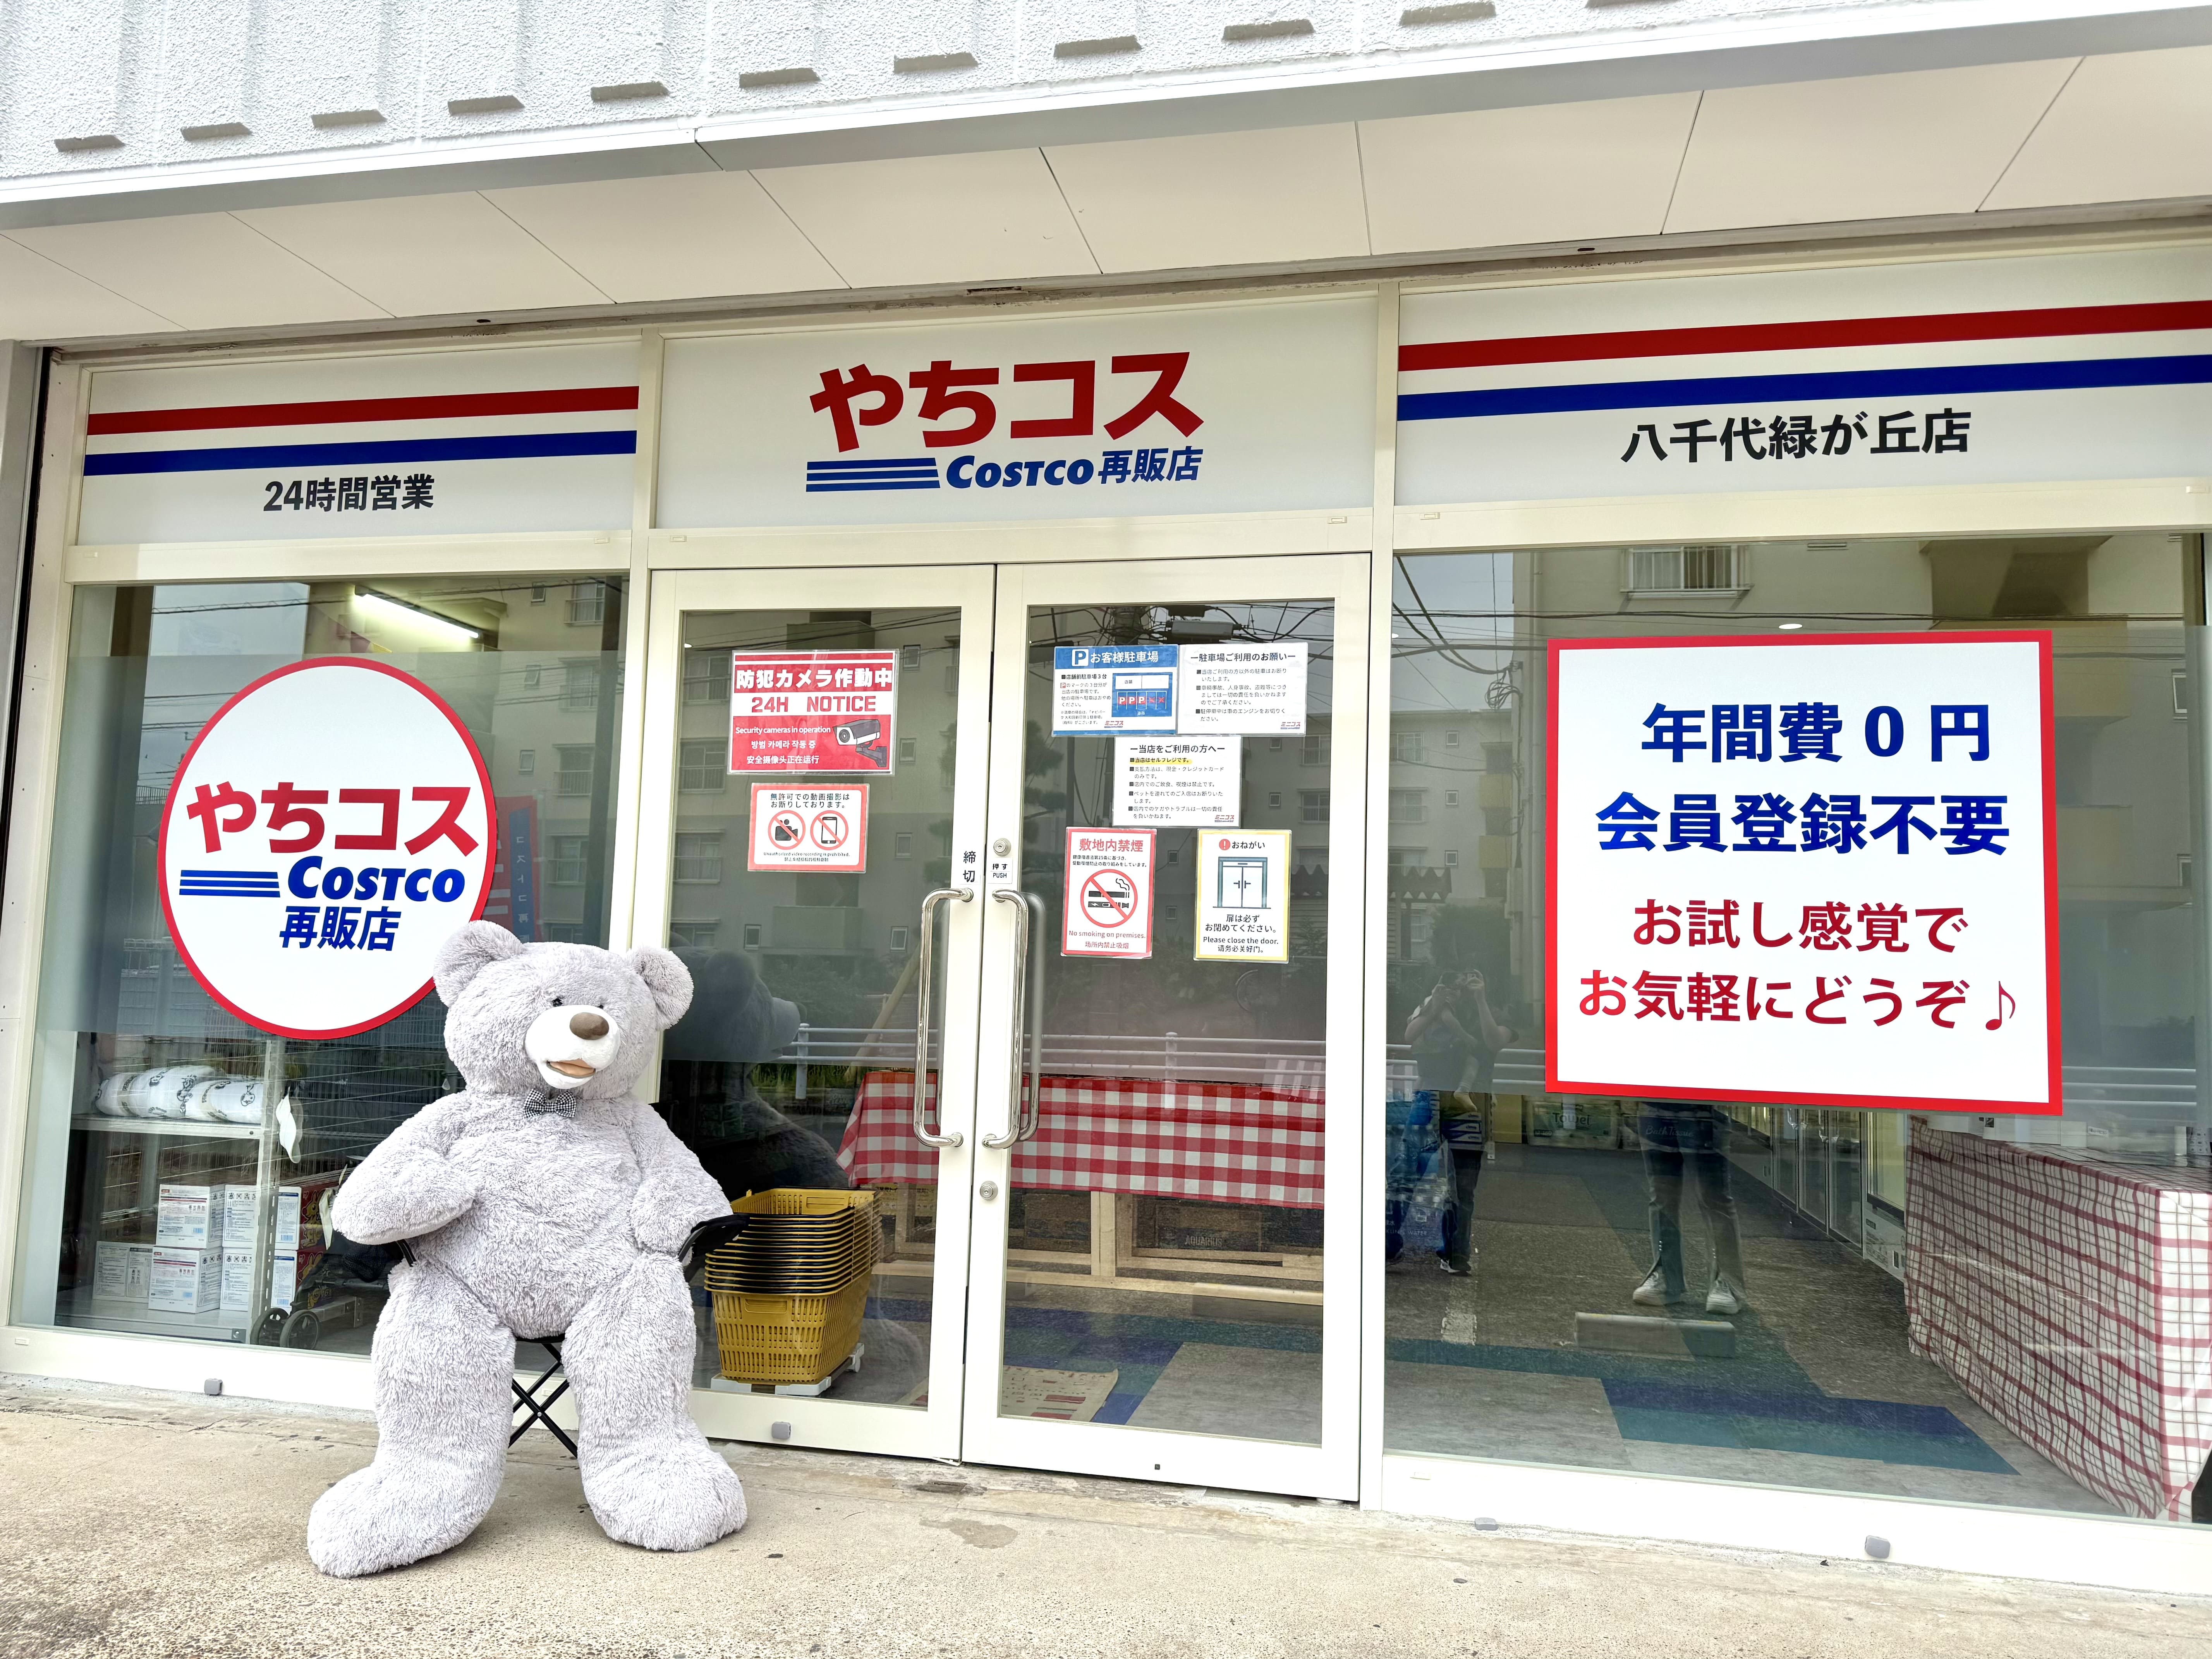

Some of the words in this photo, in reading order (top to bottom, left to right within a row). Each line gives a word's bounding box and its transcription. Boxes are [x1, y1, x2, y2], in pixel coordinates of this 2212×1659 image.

[809, 352, 1204, 452] やちコス
[1620, 408, 1972, 463] 八千代緑が丘店
[264, 474, 434, 512] 24時間営業
[1090, 651, 1159, 664] お客様駐車場
[736, 667, 893, 689] 防犯カメラ作動中
[752, 697, 788, 713] 24H
[807, 696, 876, 712] NOTICE
[736, 726, 763, 735] Security
[751, 740, 766, 749] 방범
[768, 740, 790, 749] 카메라
[792, 740, 807, 749] 작동
[808, 740, 816, 749] 중
[747, 755, 819, 764] 安全摄像头正在运行
[186, 781, 479, 857] やちコス
[1595, 791, 2009, 855] 会員登録不要
[1079, 838, 1144, 852] 敷地内禁煙
[1232, 841, 1265, 849] おねがい
[963, 851, 976, 883] 締切
[1226, 914, 1260, 922] 扉は必ず
[1633, 898, 1969, 953] お試し感覚で
[279, 906, 402, 951] 再販店
[1205, 923, 1276, 933] お閉めてください。
[1645, 1125, 1668, 1135] Bath
